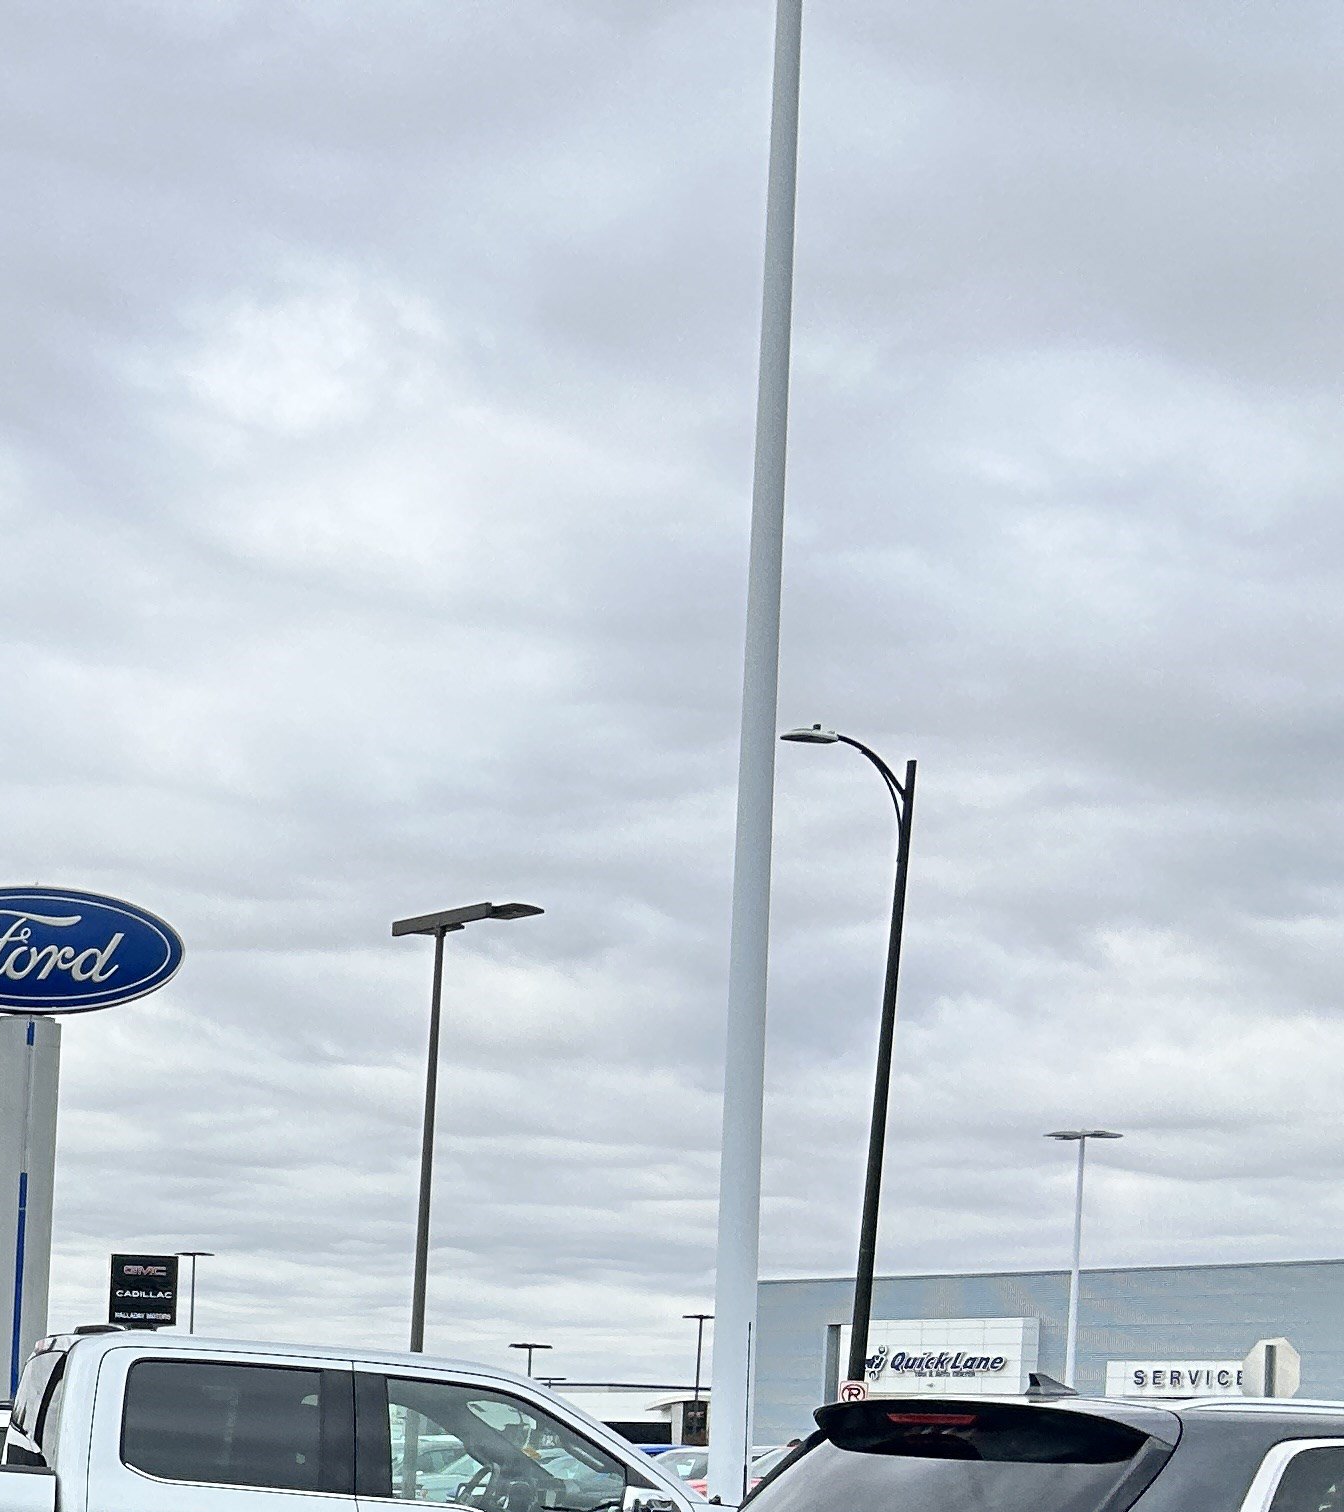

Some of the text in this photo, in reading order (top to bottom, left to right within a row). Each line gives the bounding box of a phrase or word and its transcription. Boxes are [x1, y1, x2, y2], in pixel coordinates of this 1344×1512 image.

[123, 1265, 166, 1276] GMC
[115, 1290, 173, 1299] CADILLAC
[890, 1351, 1004, 1371] Quick Lane
[1133, 1369, 1243, 1386] SERVICE
